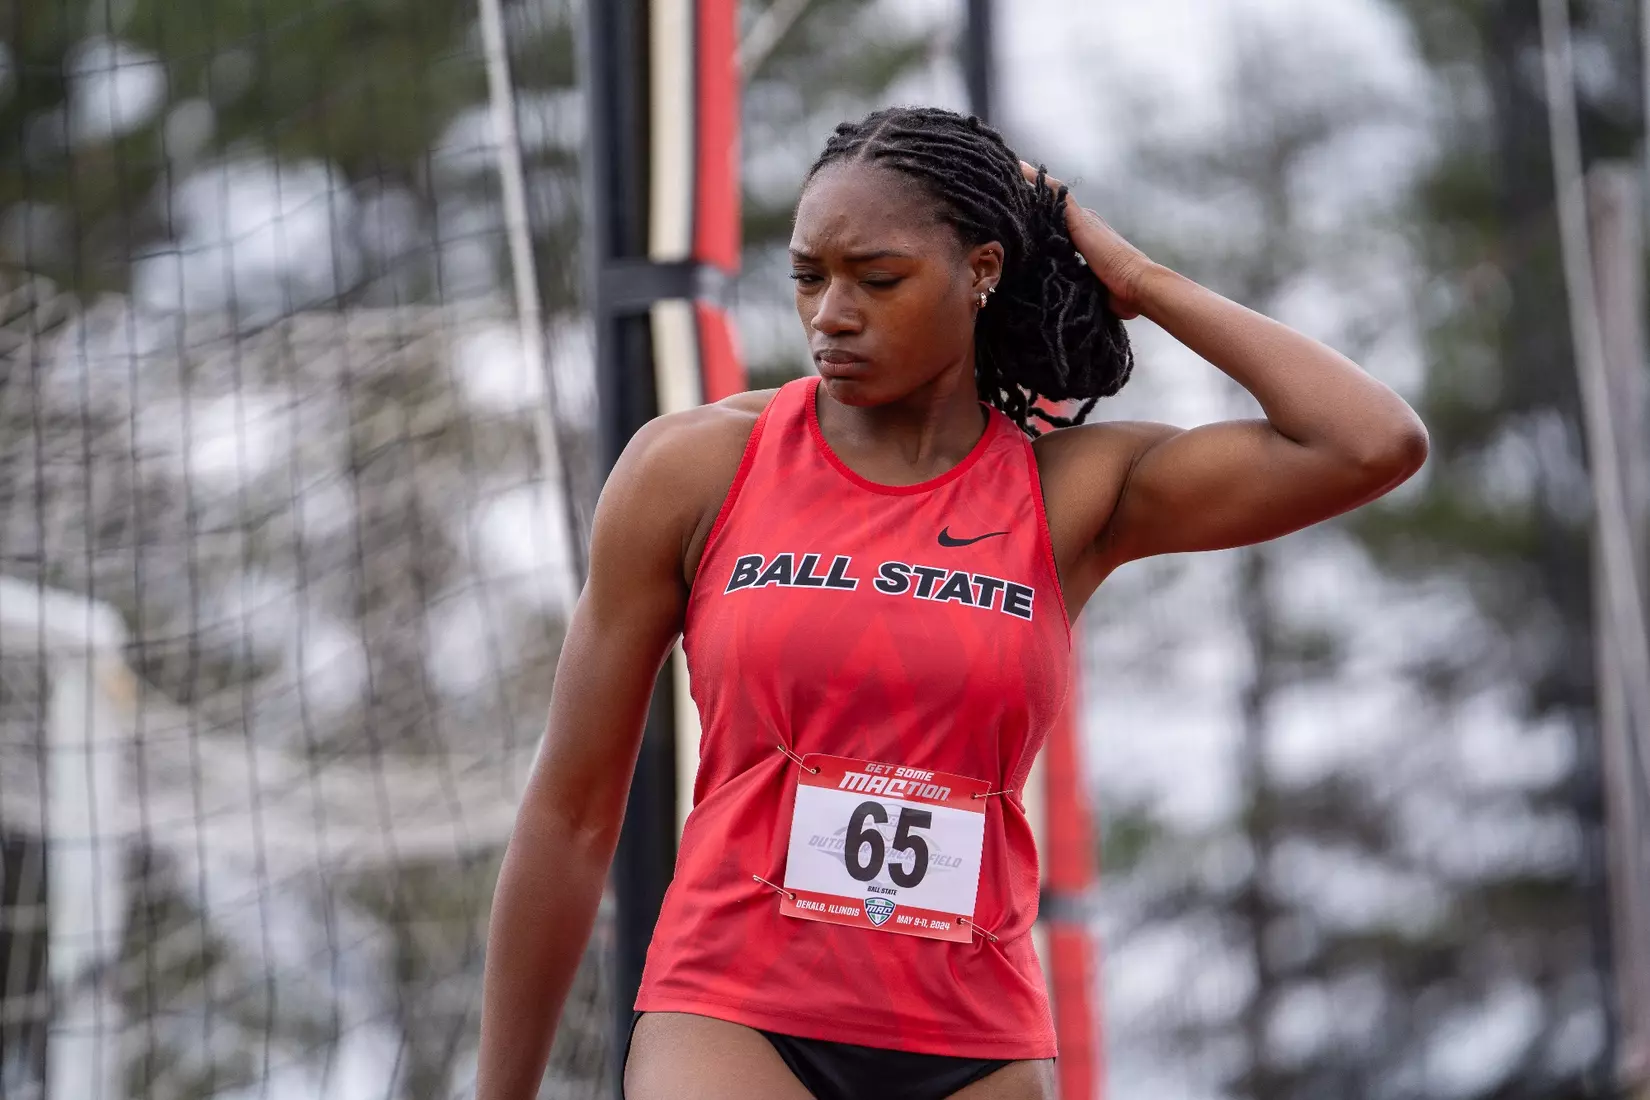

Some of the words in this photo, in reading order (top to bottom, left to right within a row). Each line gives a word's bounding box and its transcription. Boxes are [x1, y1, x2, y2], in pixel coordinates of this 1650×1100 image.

[724, 553, 859, 595] BALL
[873, 561, 1035, 621] STATE
[865, 763, 894, 775] GET
[895, 767, 935, 781] SOME
[808, 835, 871, 854] OUTDR
[845, 800, 932, 888] 65
[867, 885, 881, 894] BALL
[881, 887, 898, 896] STATE
[828, 904, 861, 917] ILLINOIS
[866, 904, 893, 915] MAC
[896, 914, 914, 925] MAY
[930, 920, 951, 931] 2024
